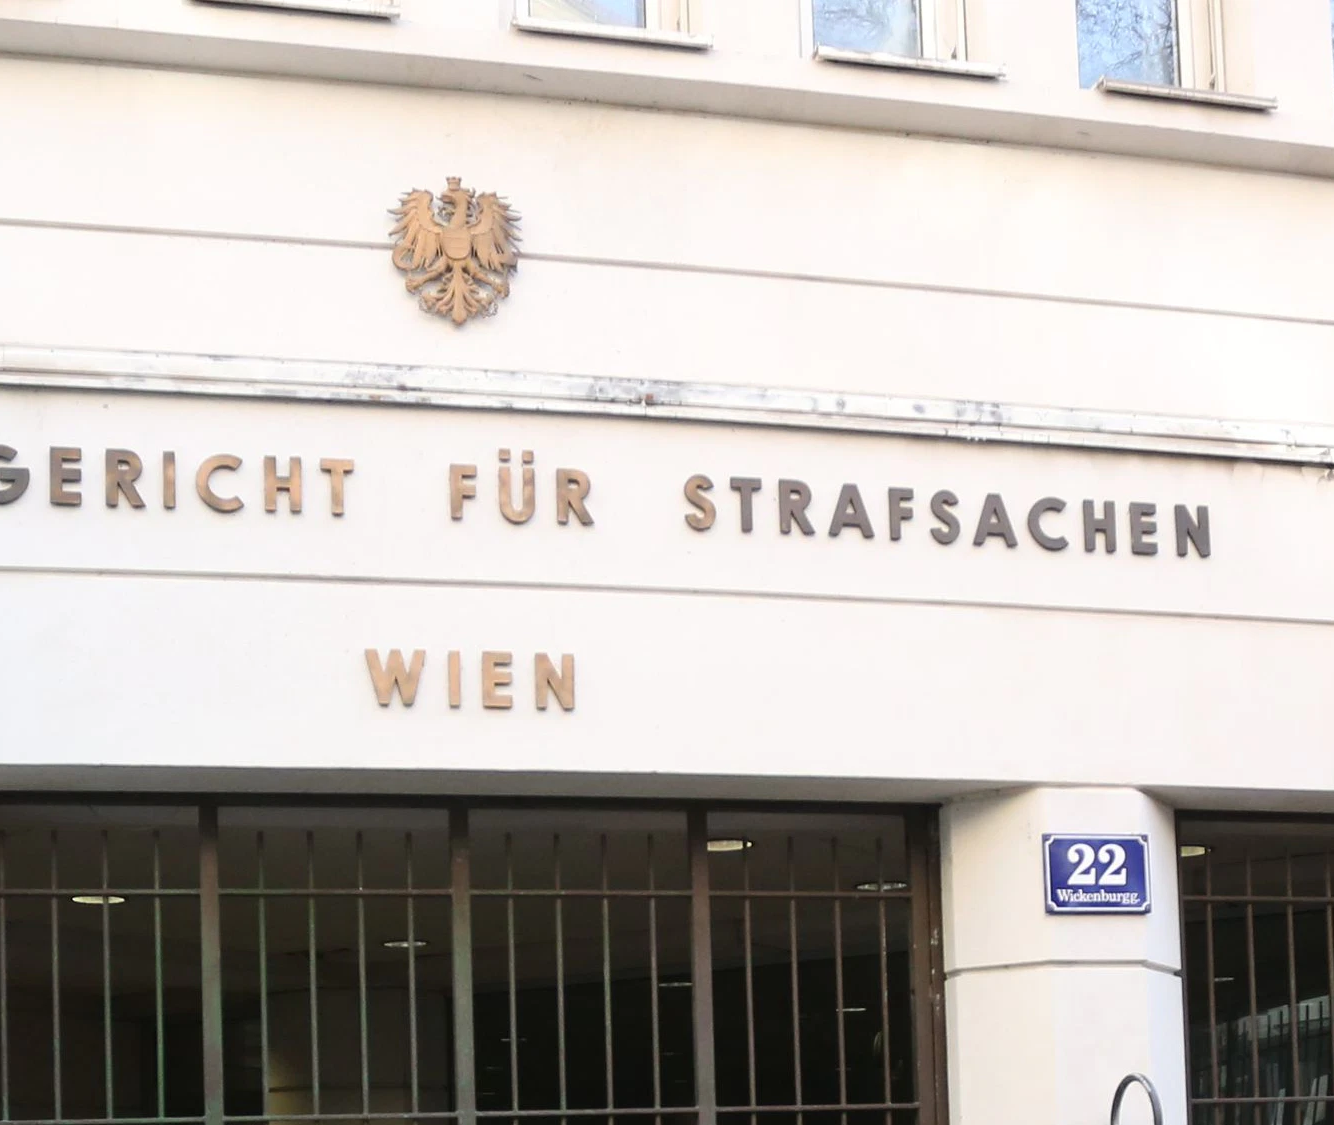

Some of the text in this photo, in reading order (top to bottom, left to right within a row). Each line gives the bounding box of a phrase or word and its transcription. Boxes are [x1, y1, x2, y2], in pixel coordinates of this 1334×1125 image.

[449, 448, 594, 527] FÜR
[685, 474, 1212, 558] STRAFSACHEN
[364, 649, 576, 712] WIEN
[1067, 843, 1127, 885] 22
